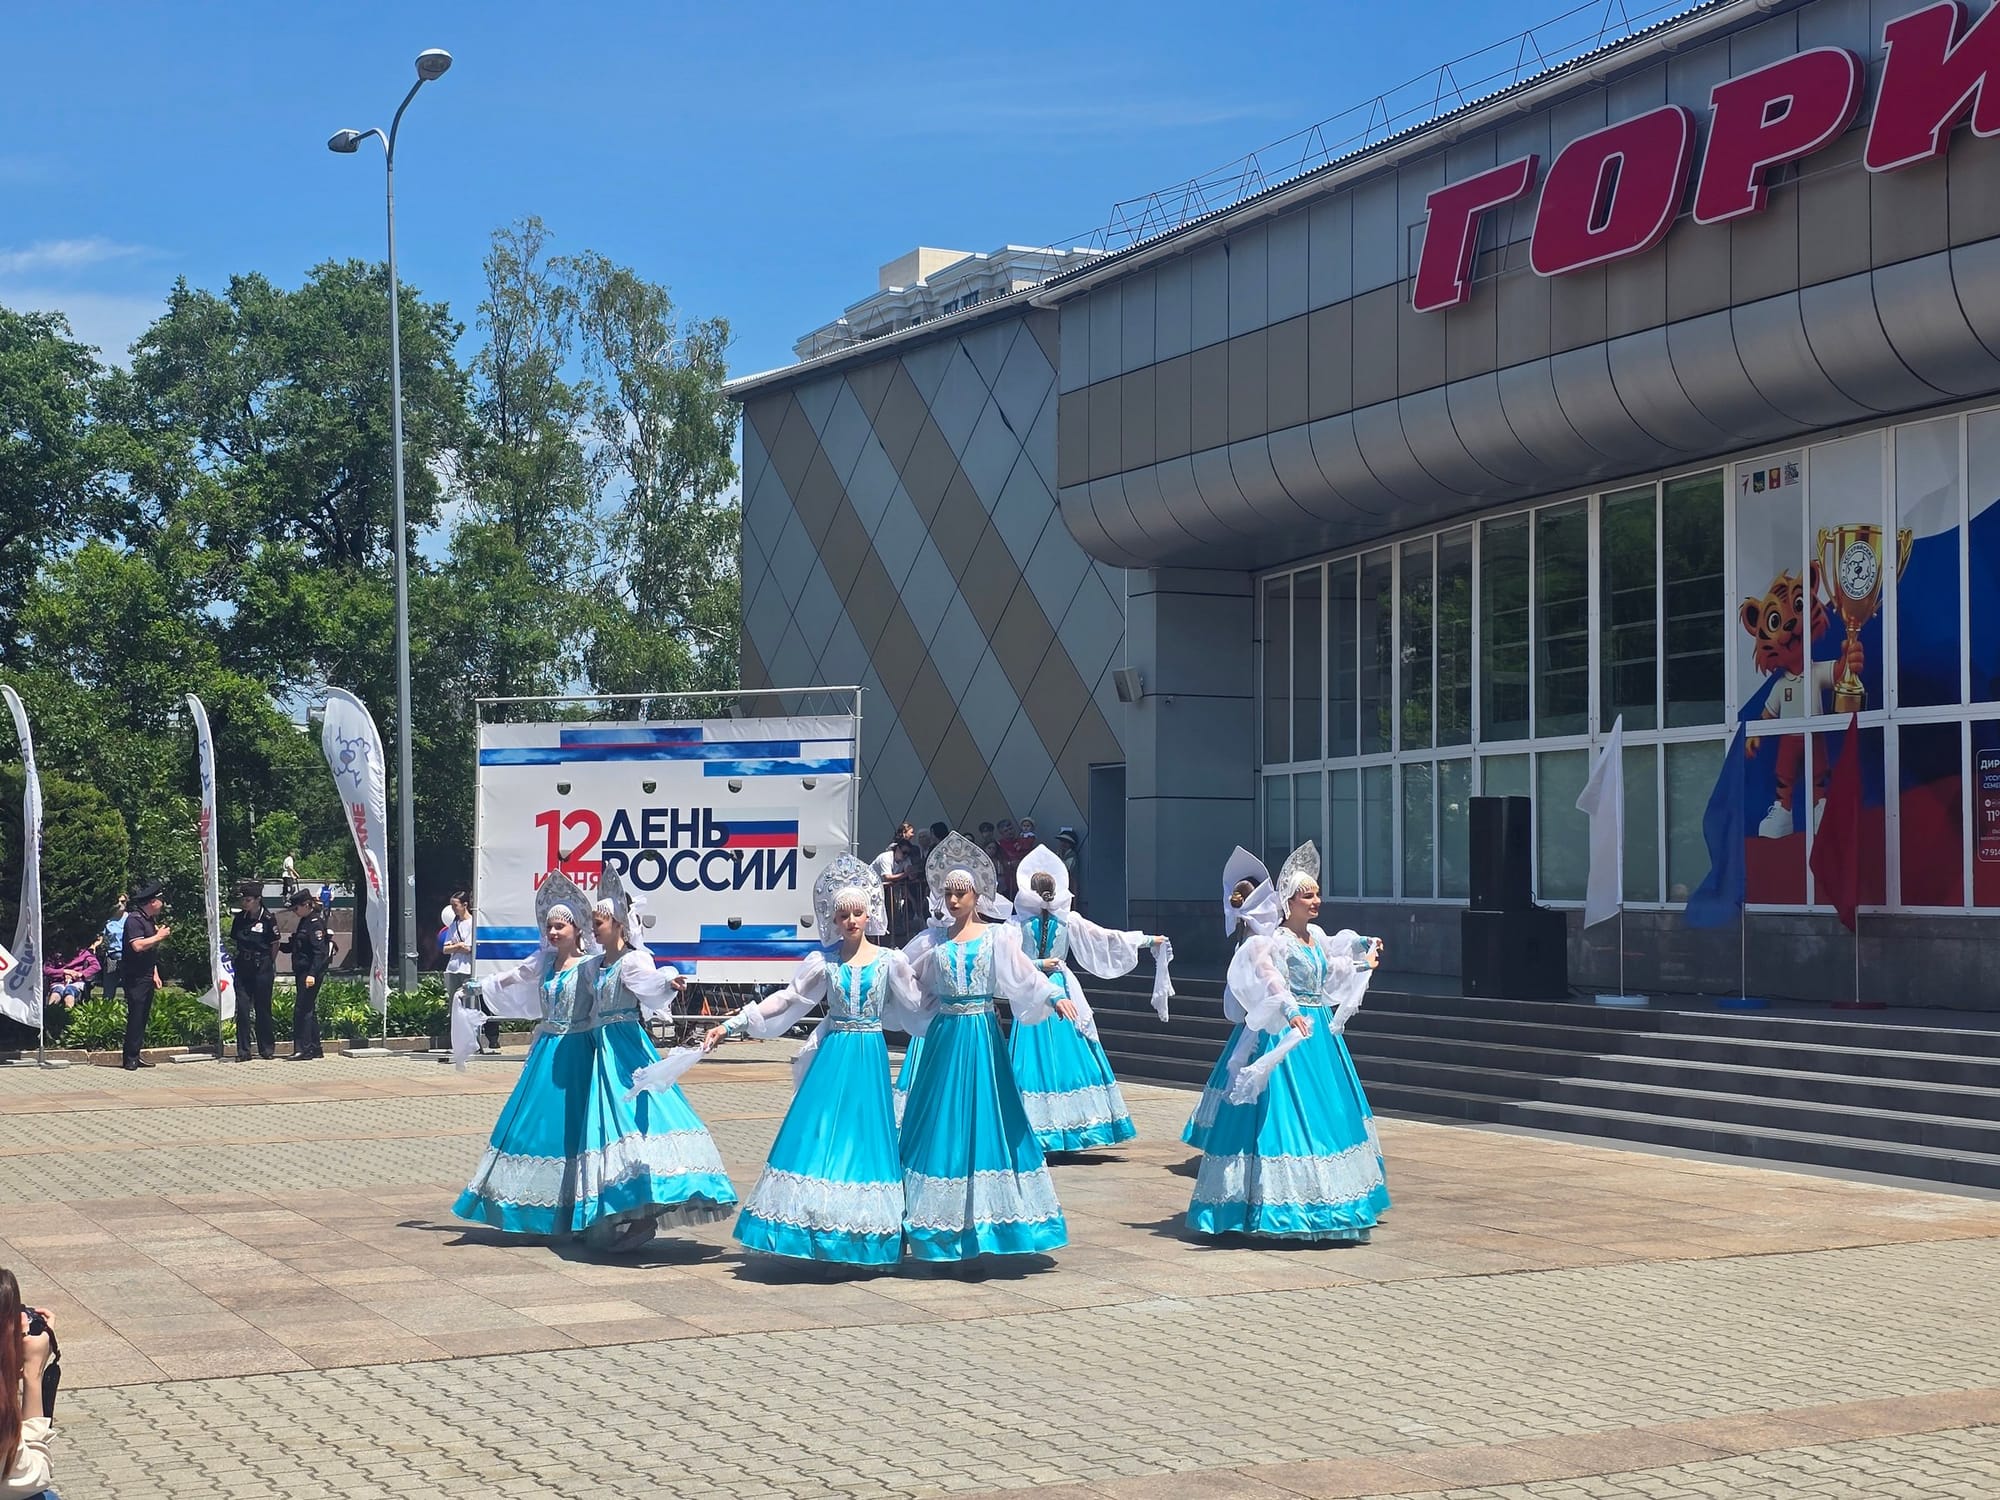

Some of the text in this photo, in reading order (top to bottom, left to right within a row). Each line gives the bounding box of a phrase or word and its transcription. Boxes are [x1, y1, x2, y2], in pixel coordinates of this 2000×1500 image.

[535, 808, 729, 872] 12 ДЕНЬ
[534, 872, 602, 891] ИНЯ
[602, 849, 797, 892] РОССИИ
